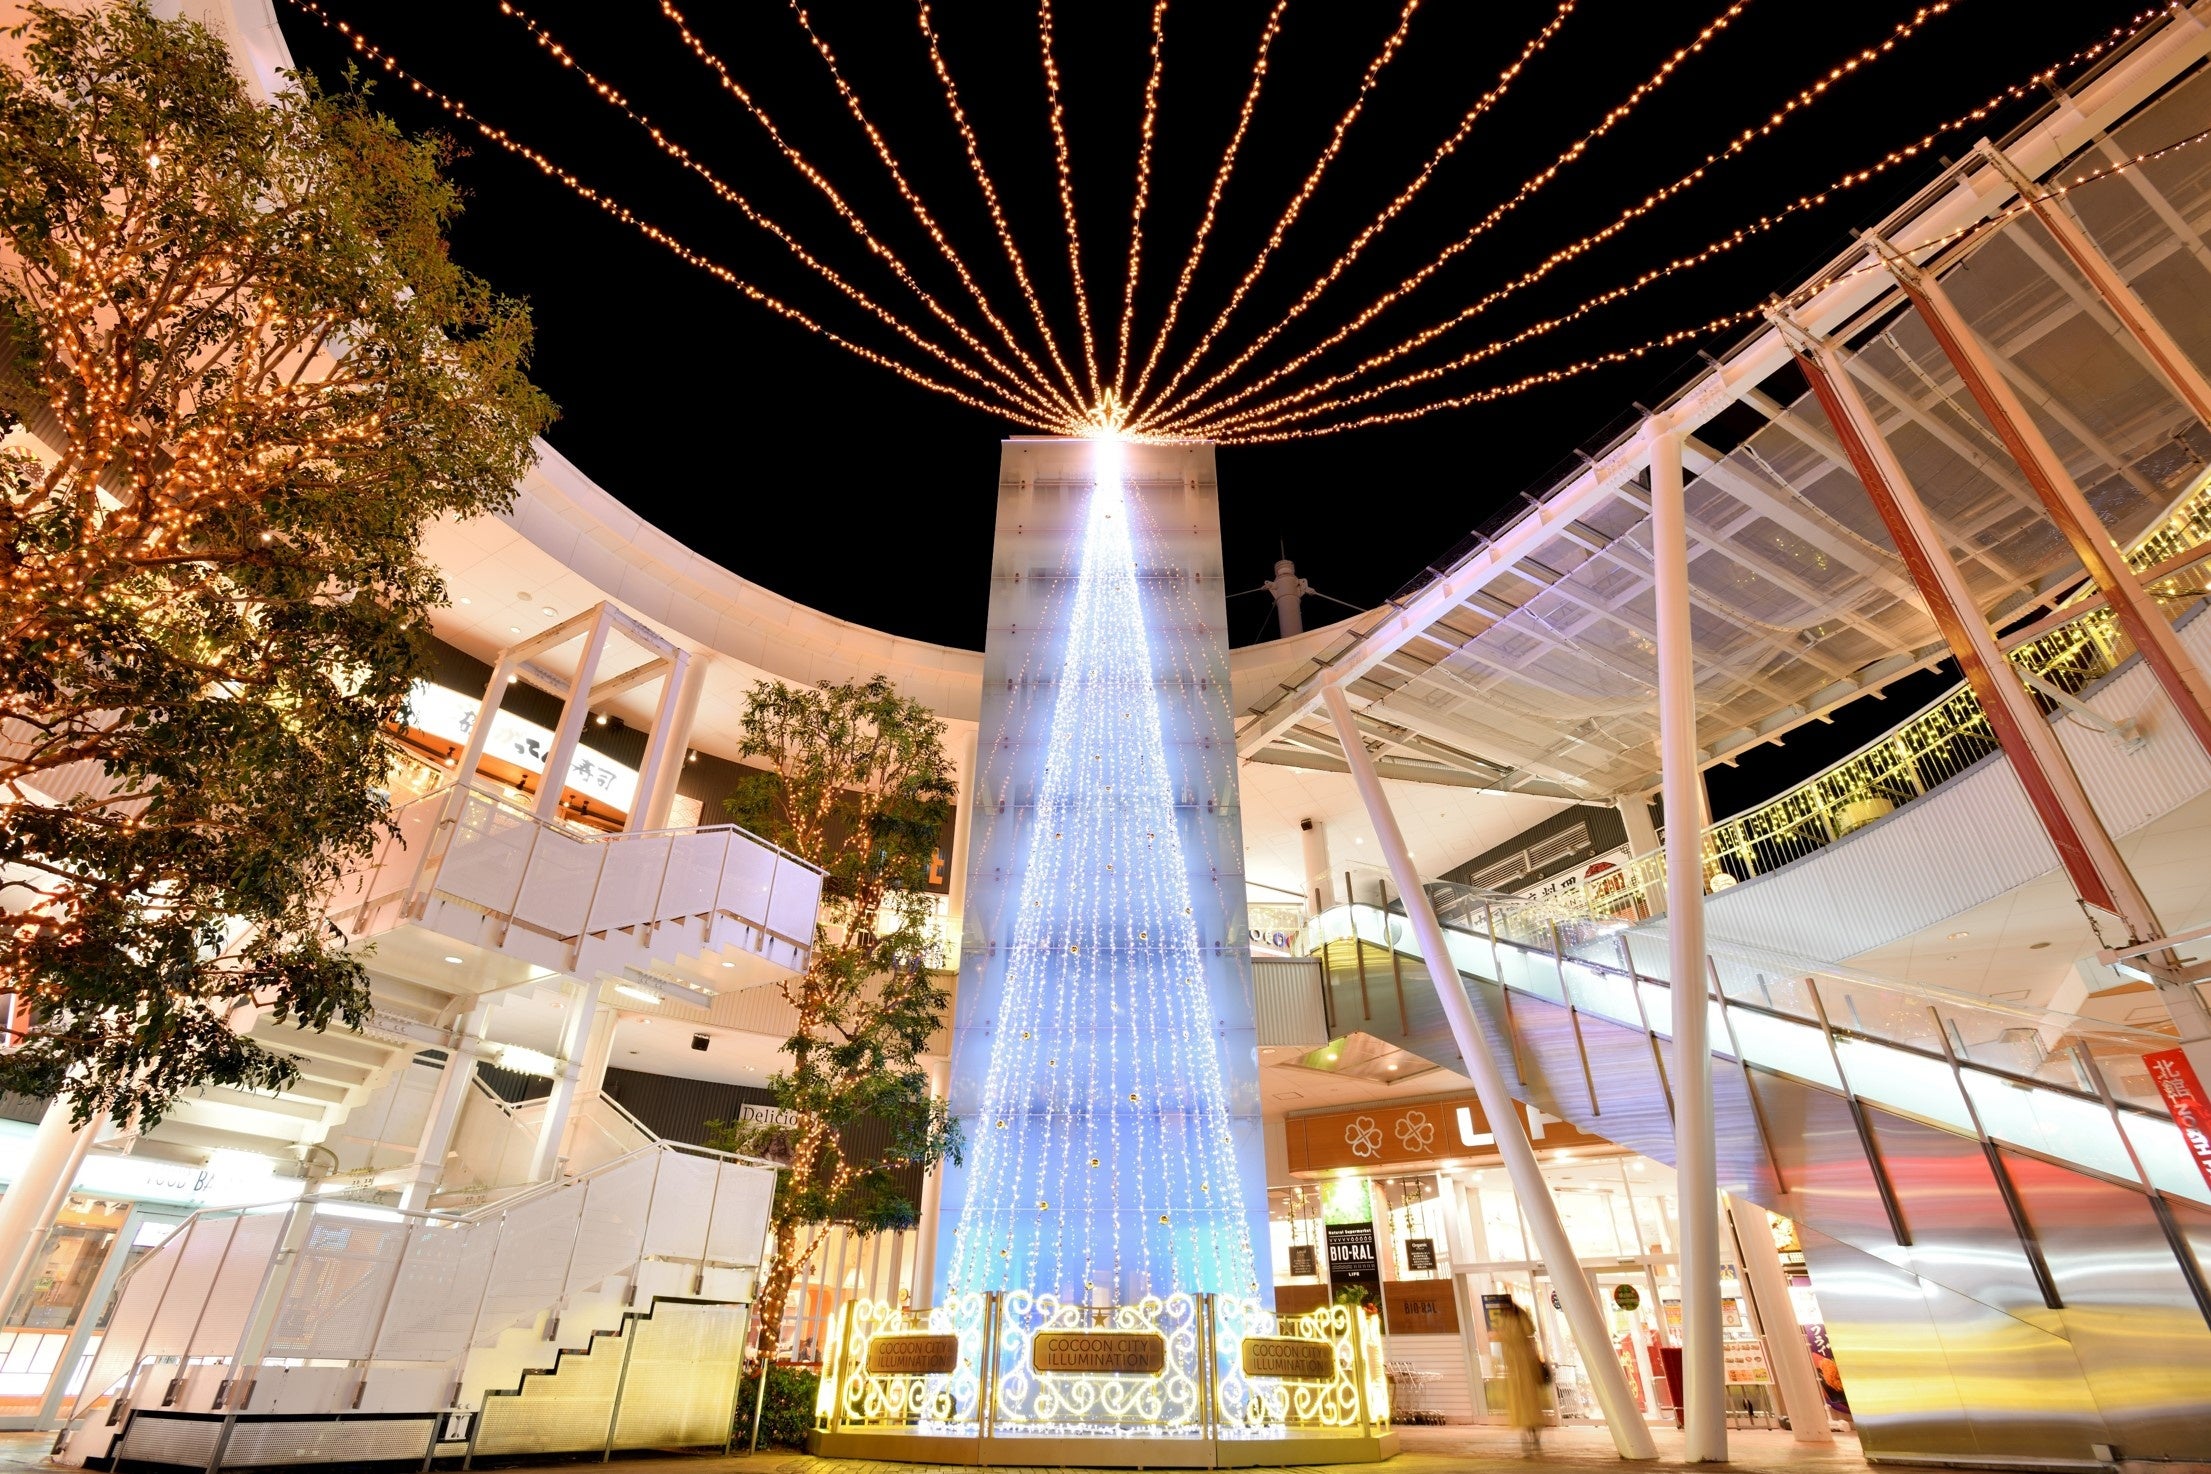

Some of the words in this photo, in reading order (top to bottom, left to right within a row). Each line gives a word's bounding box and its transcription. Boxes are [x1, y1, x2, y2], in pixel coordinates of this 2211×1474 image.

[743, 1106, 800, 1126] Delicio
[1329, 1243, 1375, 1262] BIO-RAL
[1404, 1302, 1438, 1315] BIO-RAL
[879, 1342, 923, 1355] COCOON
[924, 1341, 948, 1354] CITY
[1048, 1338, 1113, 1352] COCOON
[1117, 1339, 1150, 1353] CITY
[1252, 1344, 1299, 1358] COCOON
[1301, 1346, 1323, 1359] CITY
[877, 1355, 947, 1368] ILLUMINATION
[1048, 1352, 1150, 1367] ILLUMINATION
[1253, 1358, 1325, 1372] ILLUMINATION
